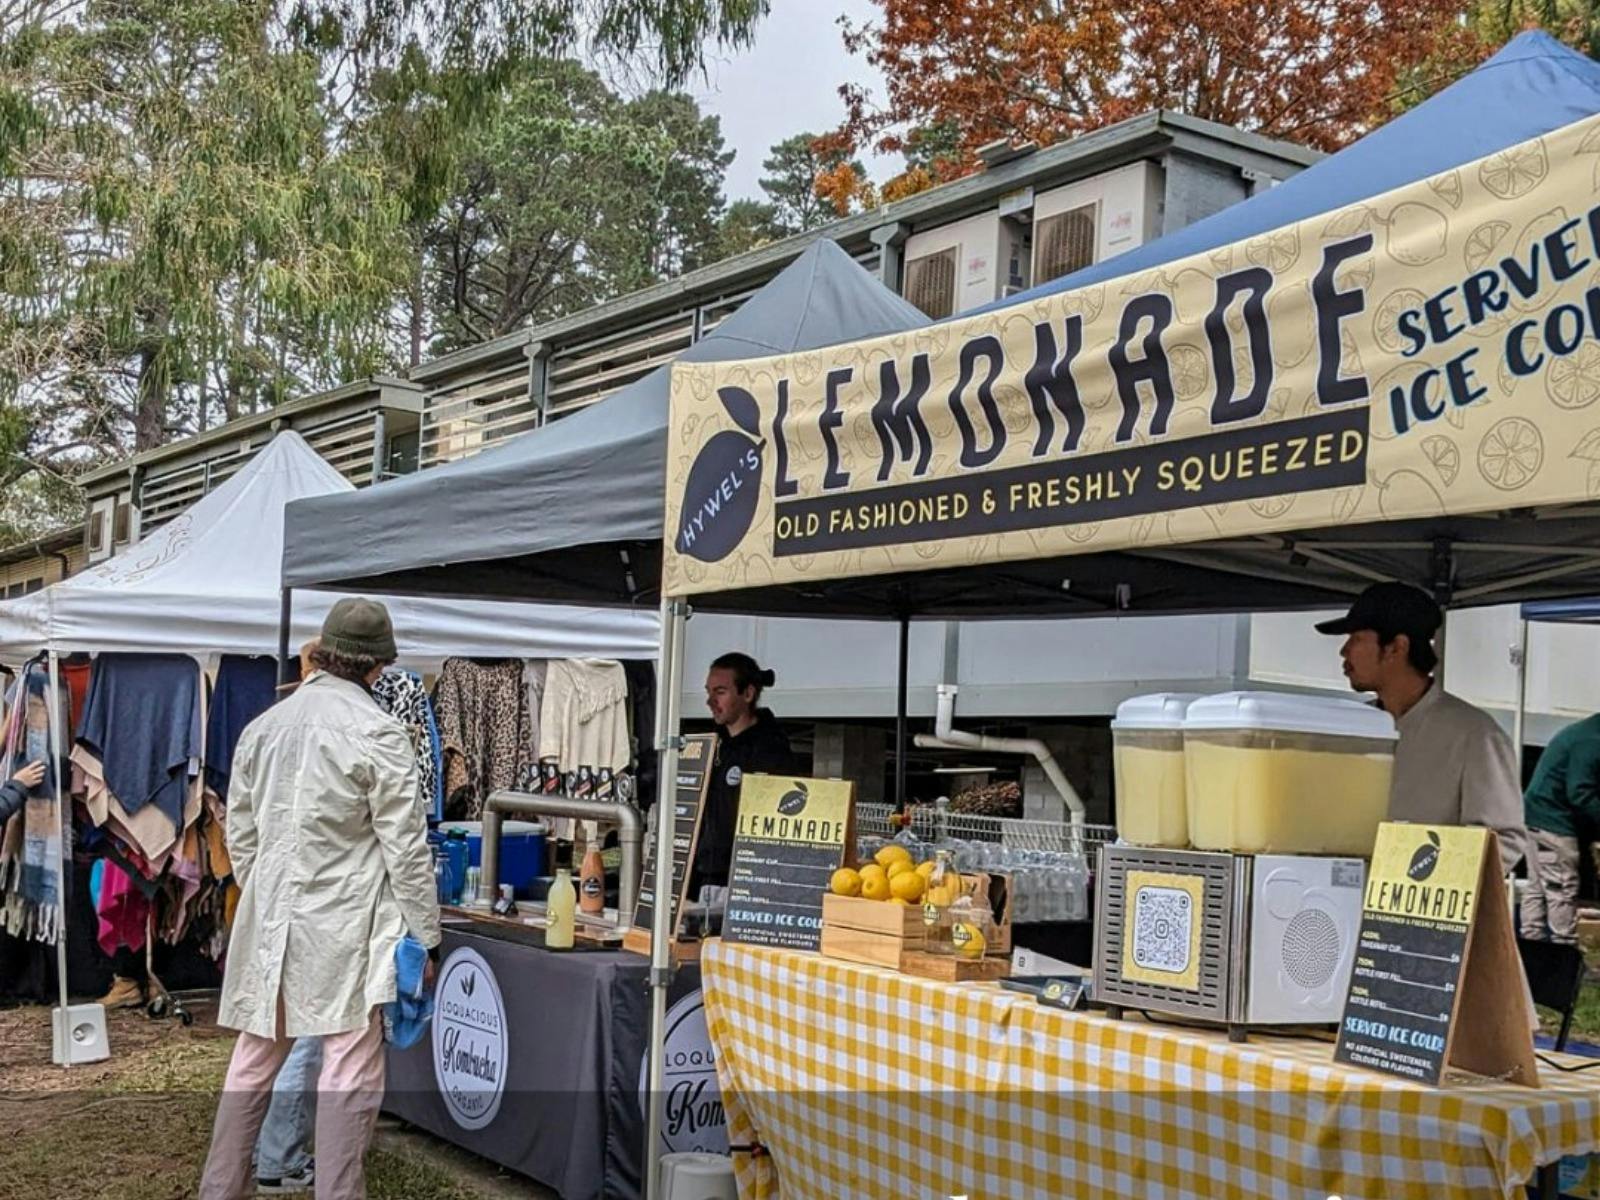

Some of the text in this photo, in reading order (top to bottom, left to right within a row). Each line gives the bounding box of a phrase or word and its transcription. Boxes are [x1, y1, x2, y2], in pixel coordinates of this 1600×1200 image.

[774, 233, 1373, 497] LEMONADE
[1390, 347, 1487, 434] ICE
[683, 448, 760, 549] HYWEL'S
[777, 429, 1363, 540] OLD FASHIONED & FRESHLY SQUEEZED
[739, 814, 842, 842] LEMONADE
[729, 909, 773, 923] SERVED
[775, 913, 796, 926] ICE
[1367, 880, 1472, 921] LEMONADE
[442, 1001, 498, 1028] LOQUACIOUS
[1345, 1016, 1444, 1053] SERVED ICE COLD!
[1345, 1041, 1355, 1050] NO
[1356, 1044, 1388, 1059] ARTIFICIAL
[442, 1026, 497, 1084] Kombucha
[1350, 1053, 1380, 1066] COLOURS
[1380, 1060, 1389, 1069] OR
